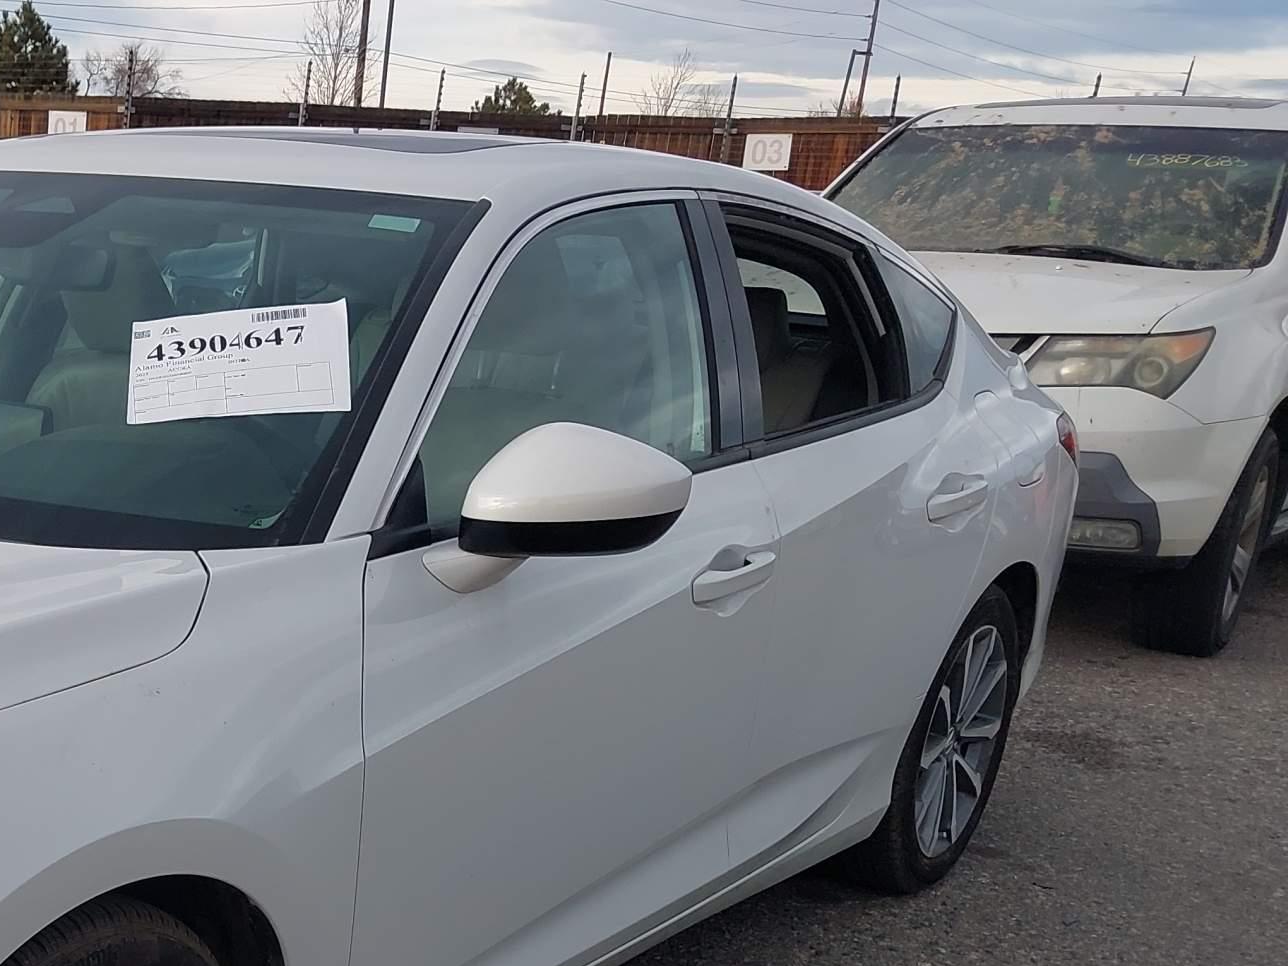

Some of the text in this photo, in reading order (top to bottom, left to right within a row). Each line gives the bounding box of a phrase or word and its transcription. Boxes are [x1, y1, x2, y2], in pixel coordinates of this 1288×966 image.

[751, 139, 783, 165] 03
[147, 326, 304, 361] 43904647
[135, 363, 164, 373] Alamo
[166, 355, 205, 367] Financial
[207, 353, 234, 362] Group
